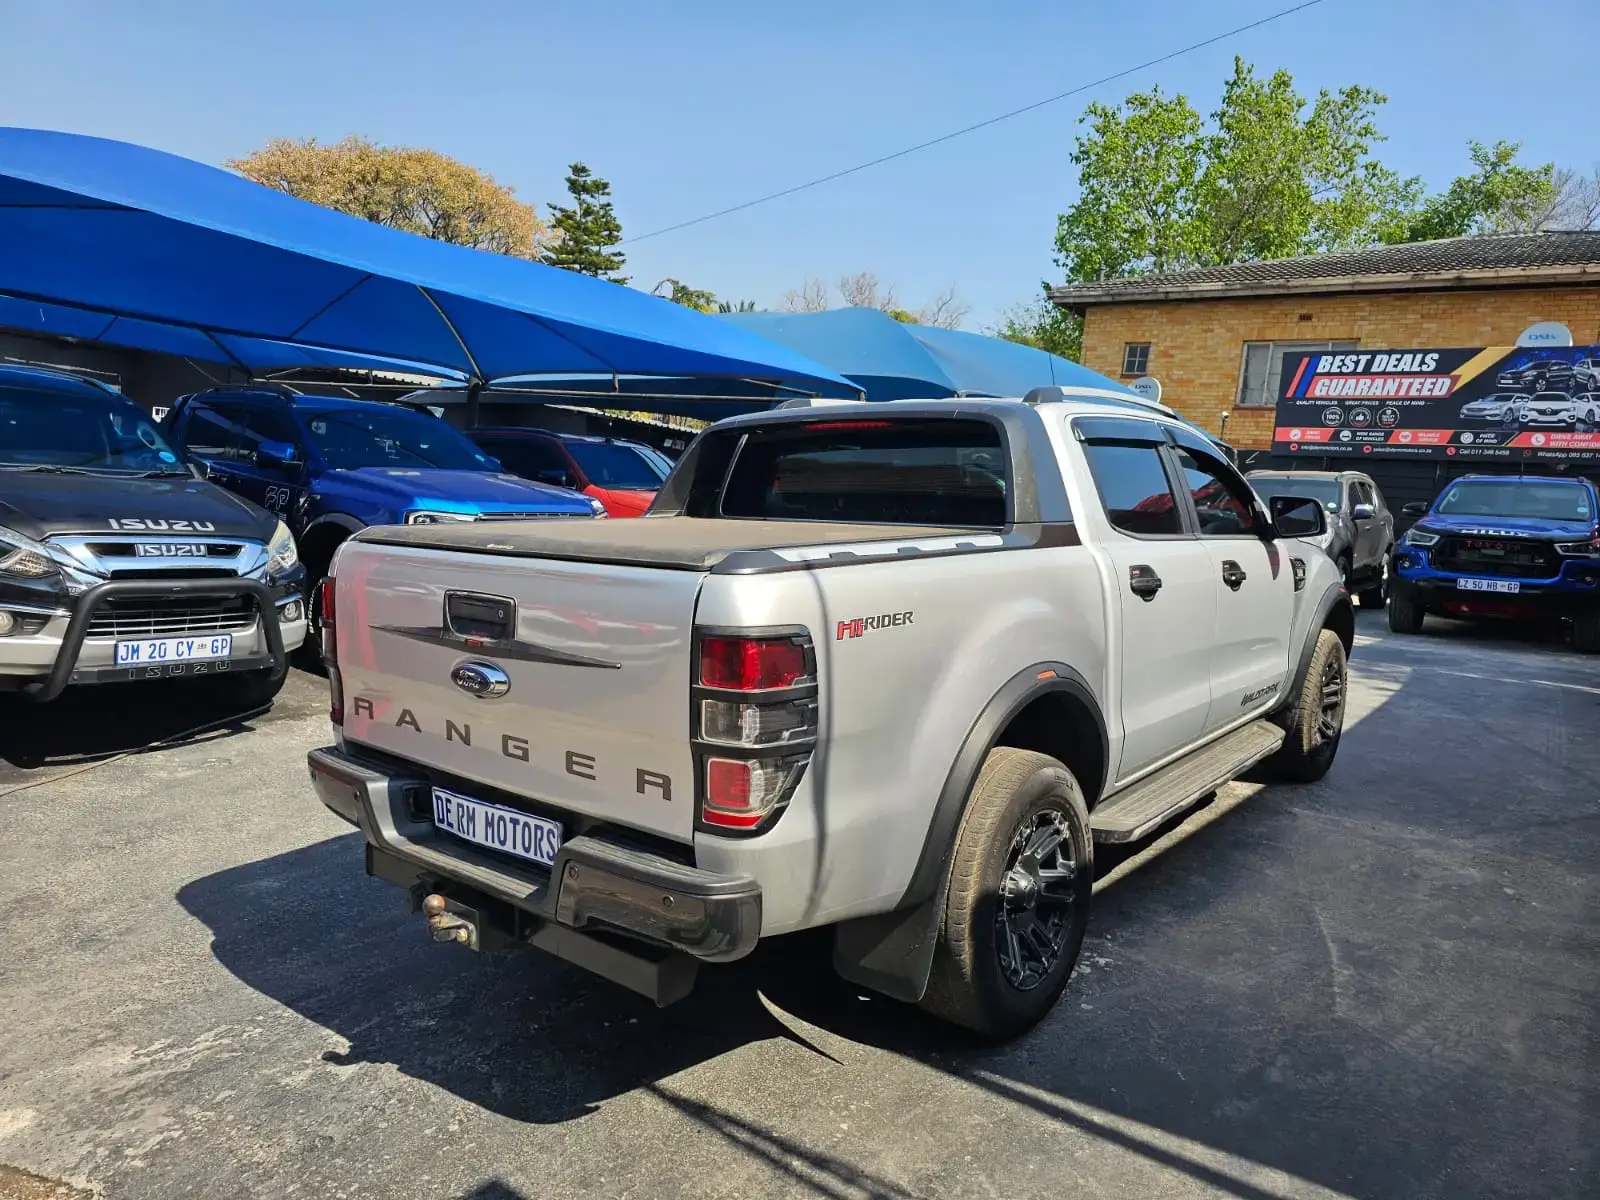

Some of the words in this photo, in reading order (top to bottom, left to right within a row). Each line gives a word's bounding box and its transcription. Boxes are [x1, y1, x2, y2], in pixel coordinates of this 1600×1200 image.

[1316, 354, 1371, 373] BEST
[1370, 353, 1440, 372] DEALS
[1314, 378, 1452, 396] GUARANTEED
[1537, 451, 1568, 459] WhatsApp
[108, 518, 216, 532] ISUZU
[1460, 529, 1533, 538] HILUX
[138, 543, 206, 557] ISUZU
[1458, 579, 1469, 589] LZ
[1472, 580, 1483, 590] 50
[1486, 581, 1498, 591] HB
[1507, 583, 1519, 592] GP
[121, 643, 141, 661] JM
[148, 642, 168, 660] 20
[176, 640, 195, 657] CY
[211, 638, 229, 655] GP
[128, 660, 231, 680] ISUZU
[353, 696, 672, 801] RANGER
[484, 810, 556, 861] MOTORS
